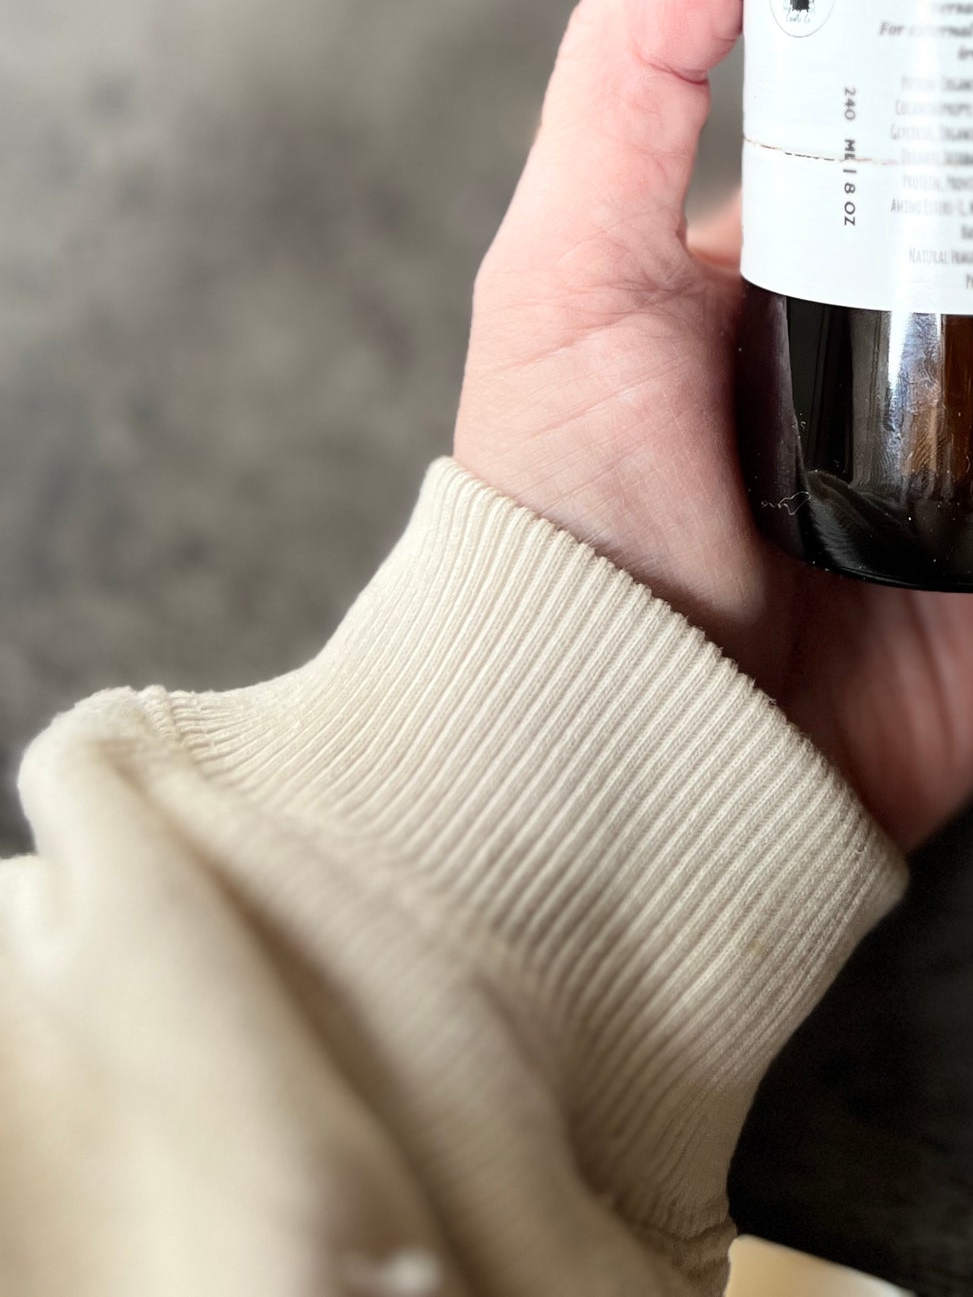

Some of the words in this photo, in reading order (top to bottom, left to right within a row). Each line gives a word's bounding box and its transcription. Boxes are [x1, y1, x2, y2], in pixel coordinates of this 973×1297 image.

[879, 21, 904, 37] For
[843, 87, 857, 121] 240
[843, 182, 857, 194] 8
[843, 201, 857, 226] OZ
